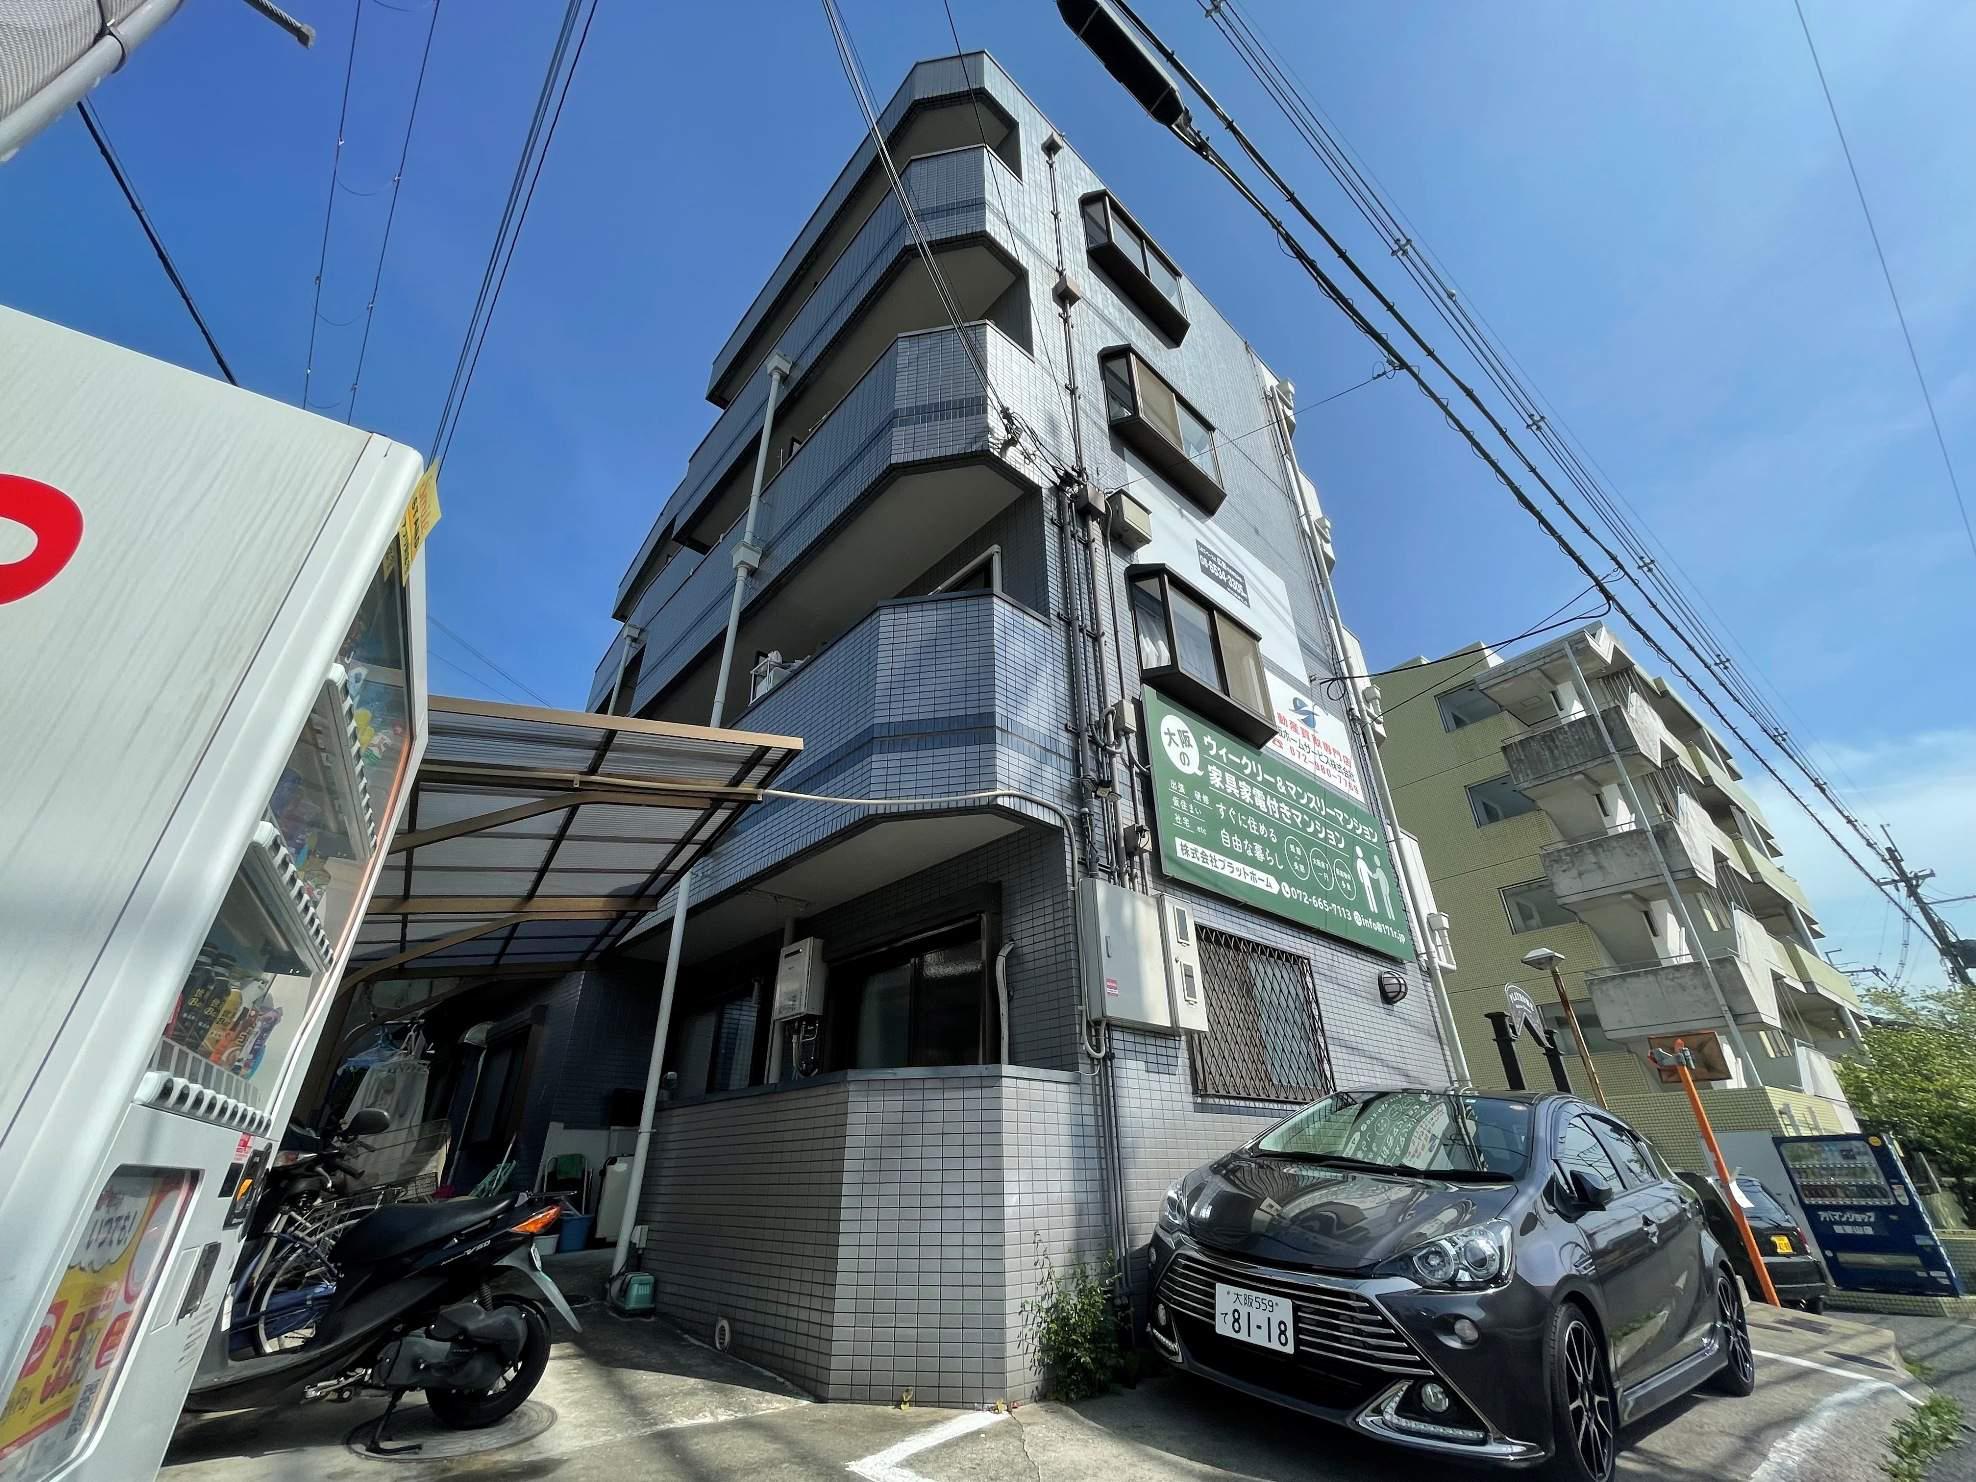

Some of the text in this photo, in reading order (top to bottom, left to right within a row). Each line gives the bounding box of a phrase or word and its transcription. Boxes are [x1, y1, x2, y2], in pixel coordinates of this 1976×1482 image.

[1164, 727, 1193, 749] 大阪
[1180, 751, 1190, 767] の
[1203, 735, 1377, 843] ウィークリー&マンスリーマンション
[1207, 764, 1345, 849] 家具家電付きマンション
[1216, 802, 1277, 843] すぐに住める
[1220, 828, 1284, 869] 自由な暮らし
[1180, 841, 1273, 889] 株式会社プラットホーム
[1291, 886, 1352, 921] 072-665-7113
[1221, 1308, 1289, 1347] て 81-18
